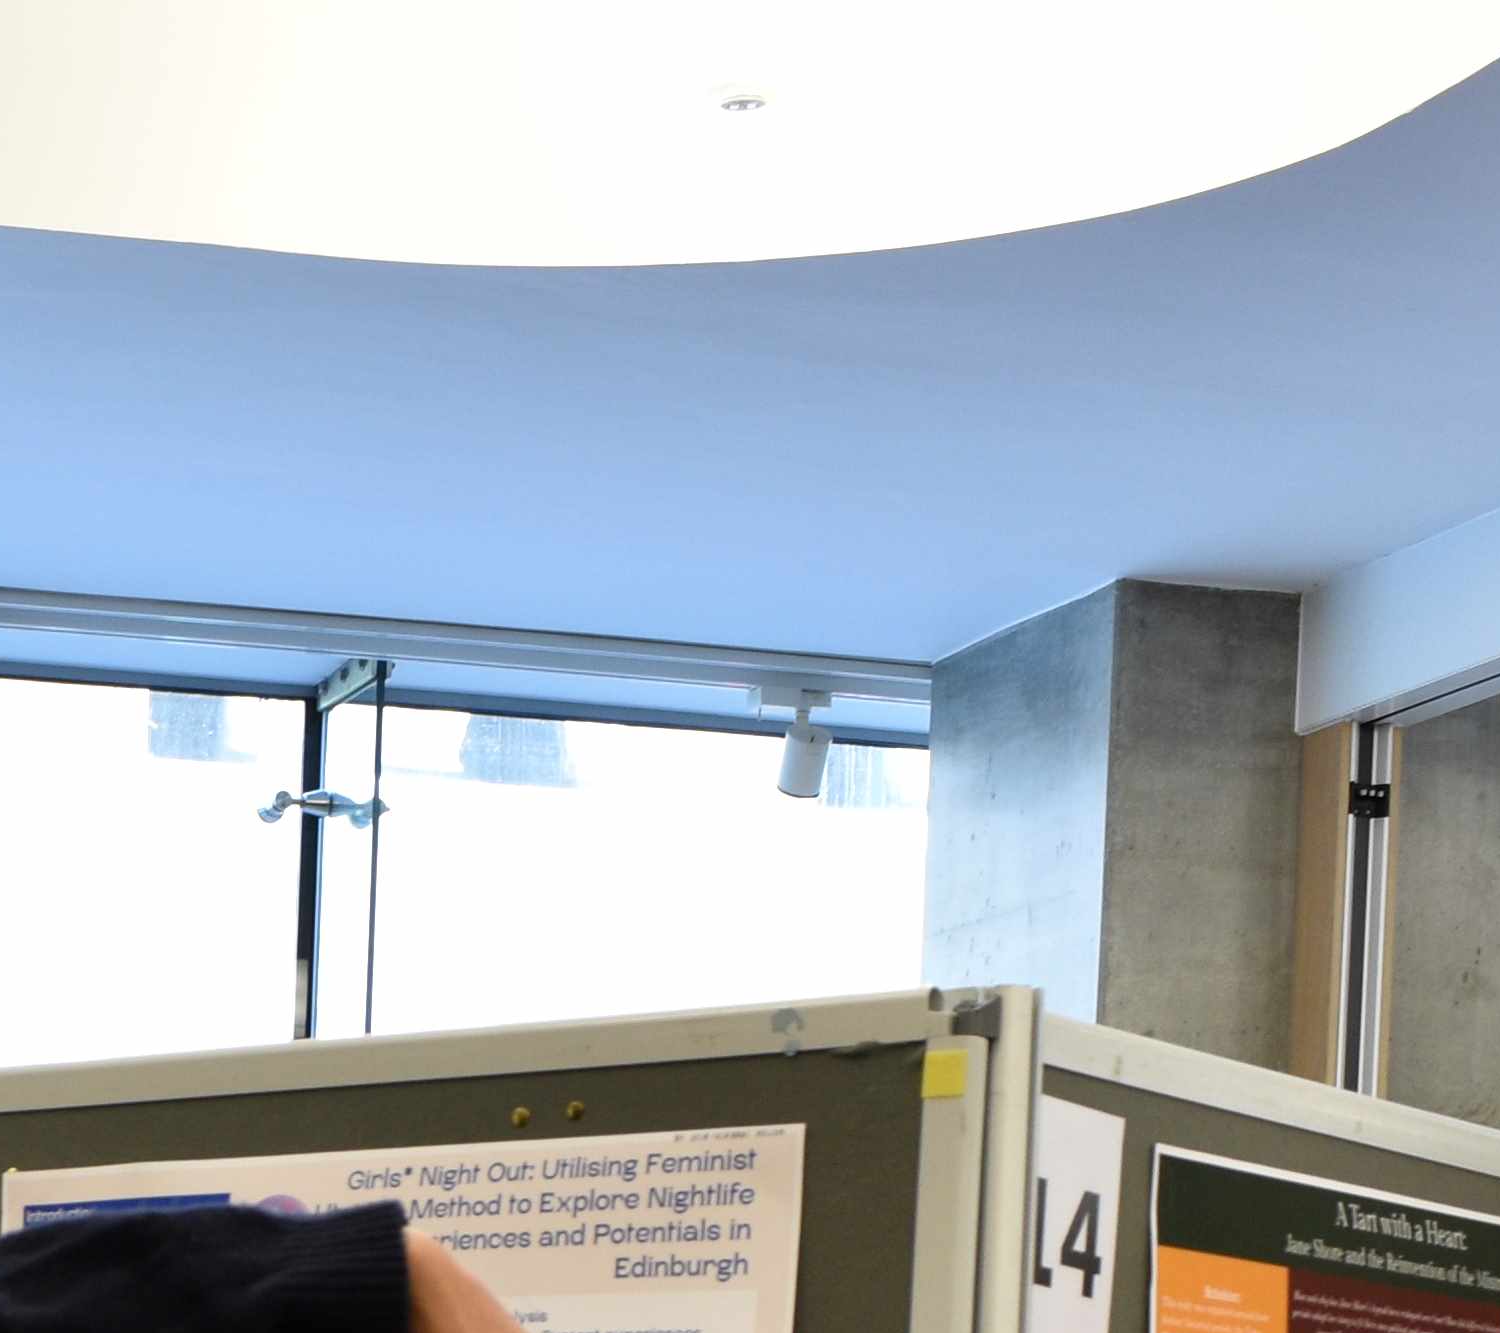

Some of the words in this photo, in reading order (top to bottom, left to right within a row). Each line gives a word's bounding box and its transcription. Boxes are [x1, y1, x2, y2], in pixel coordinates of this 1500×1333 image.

[418, 1164, 481, 1191] Night
[485, 1161, 535, 1182] Out:
[541, 1157, 639, 1181] Utilising
[644, 1150, 758, 1173] Feminist
[407, 1195, 502, 1220] Method
[508, 1194, 532, 1214] to
[538, 1190, 640, 1216] Explore
[646, 1182, 755, 1213] Nightlife
[535, 1223, 587, 1247] and
[590, 1220, 723, 1244] Potentials
[727, 1218, 752, 1240] in
[1336, 1202, 1348, 1227] A
[1348, 1204, 1377, 1232] Tart
[1379, 1213, 1412, 1239] with
[1414, 1223, 1423, 1242] a
[1425, 1220, 1467, 1250] Heart:
[611, 1254, 749, 1281] Edinburgh
